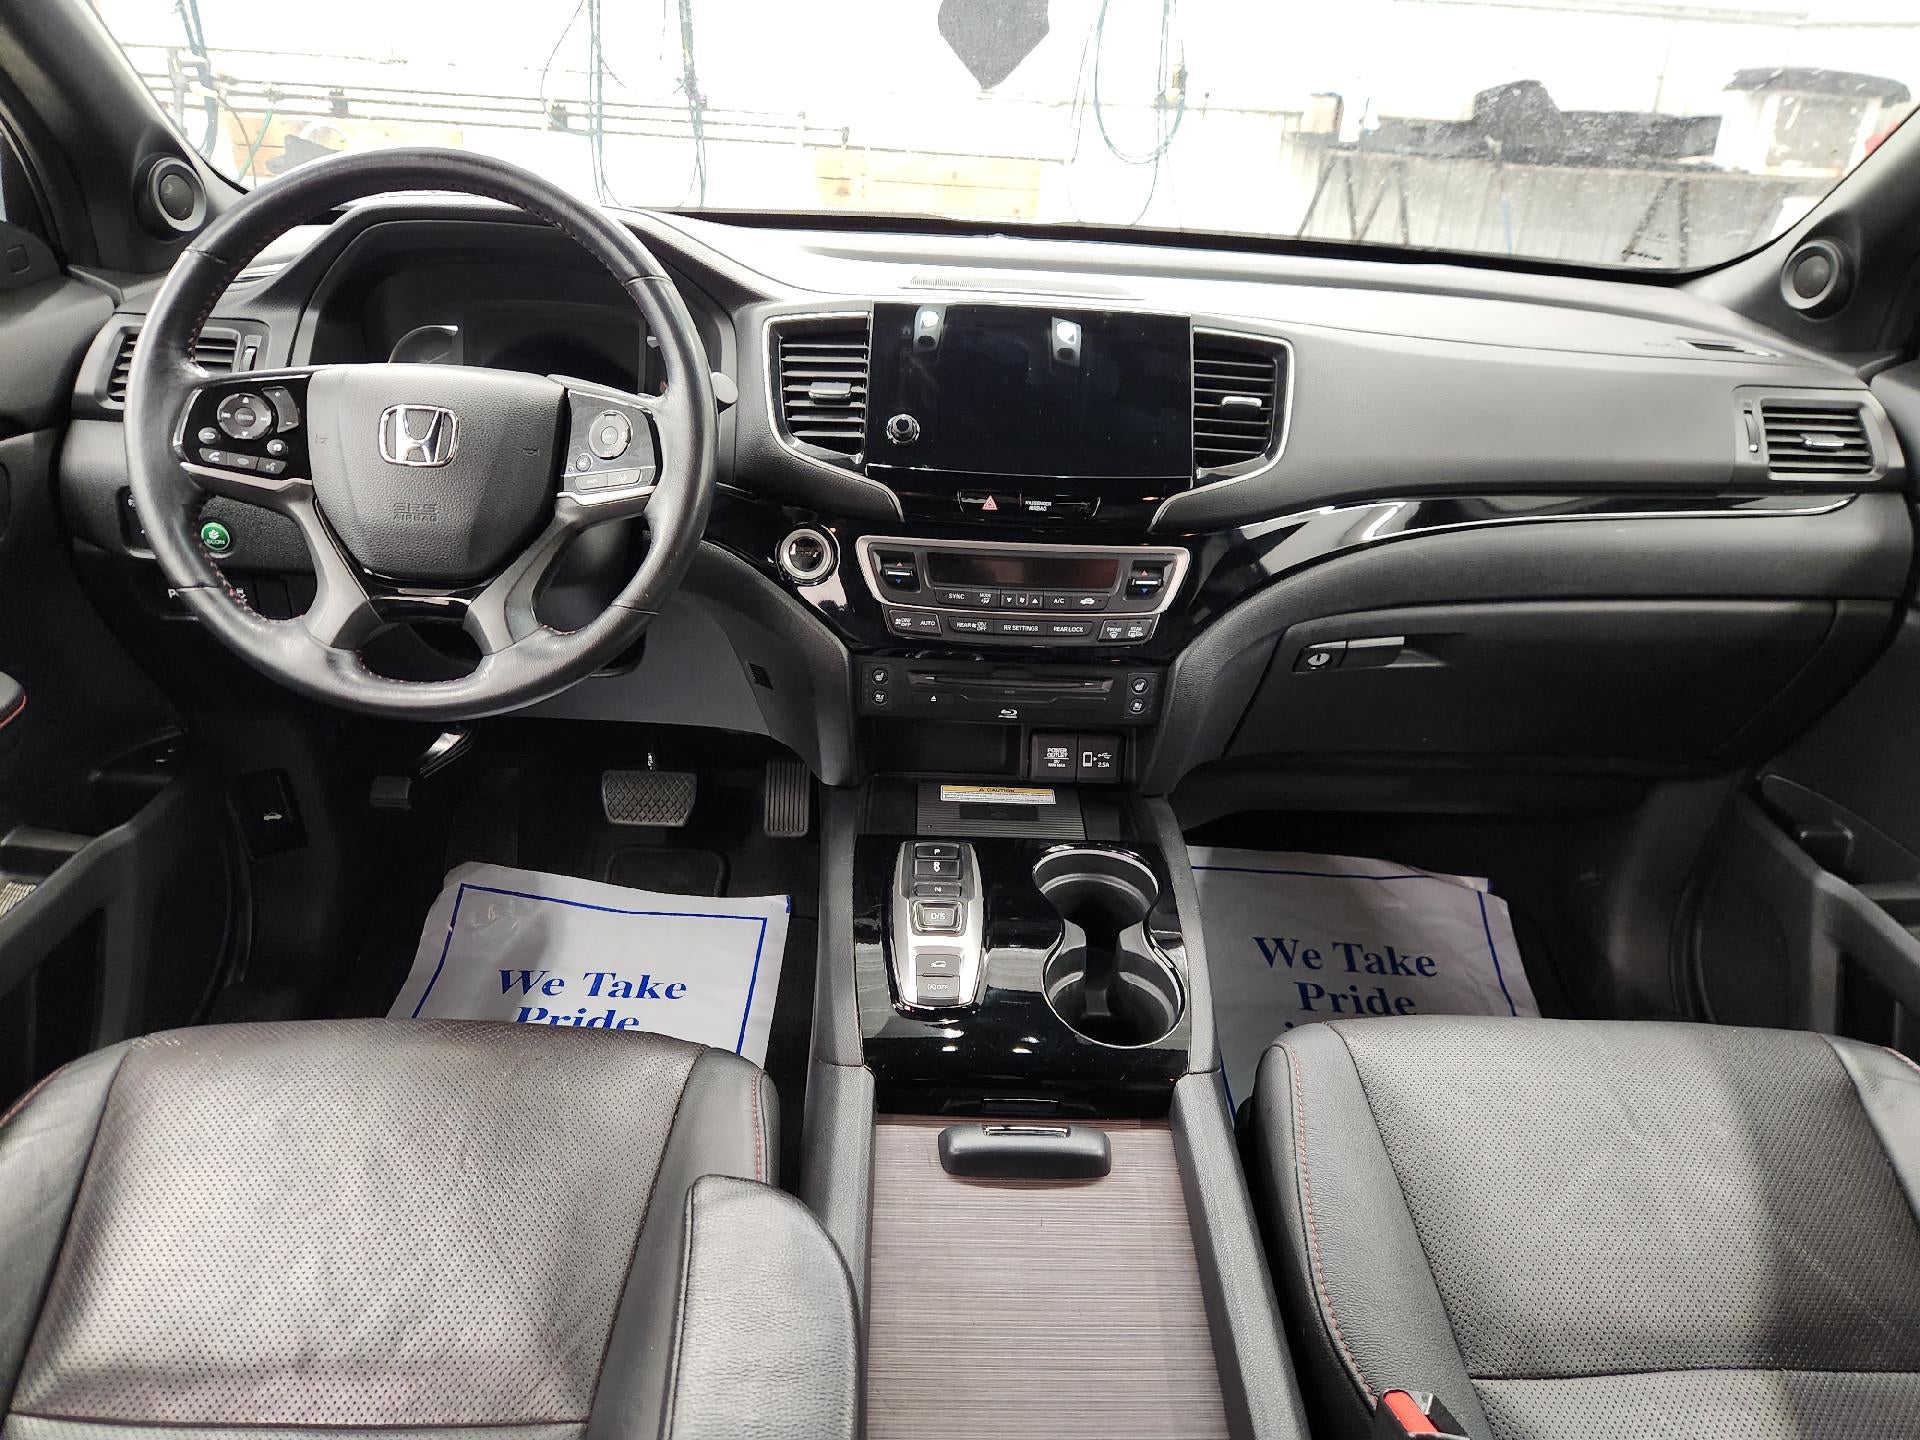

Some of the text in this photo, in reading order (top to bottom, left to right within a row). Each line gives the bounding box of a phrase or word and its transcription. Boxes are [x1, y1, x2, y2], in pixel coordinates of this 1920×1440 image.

[930, 912, 946, 920] D/S
[1252, 937, 1438, 977] We Take
[499, 970, 687, 1000] We Take
[1293, 982, 1417, 1016] Pride
[516, 1006, 641, 1030] Pride
